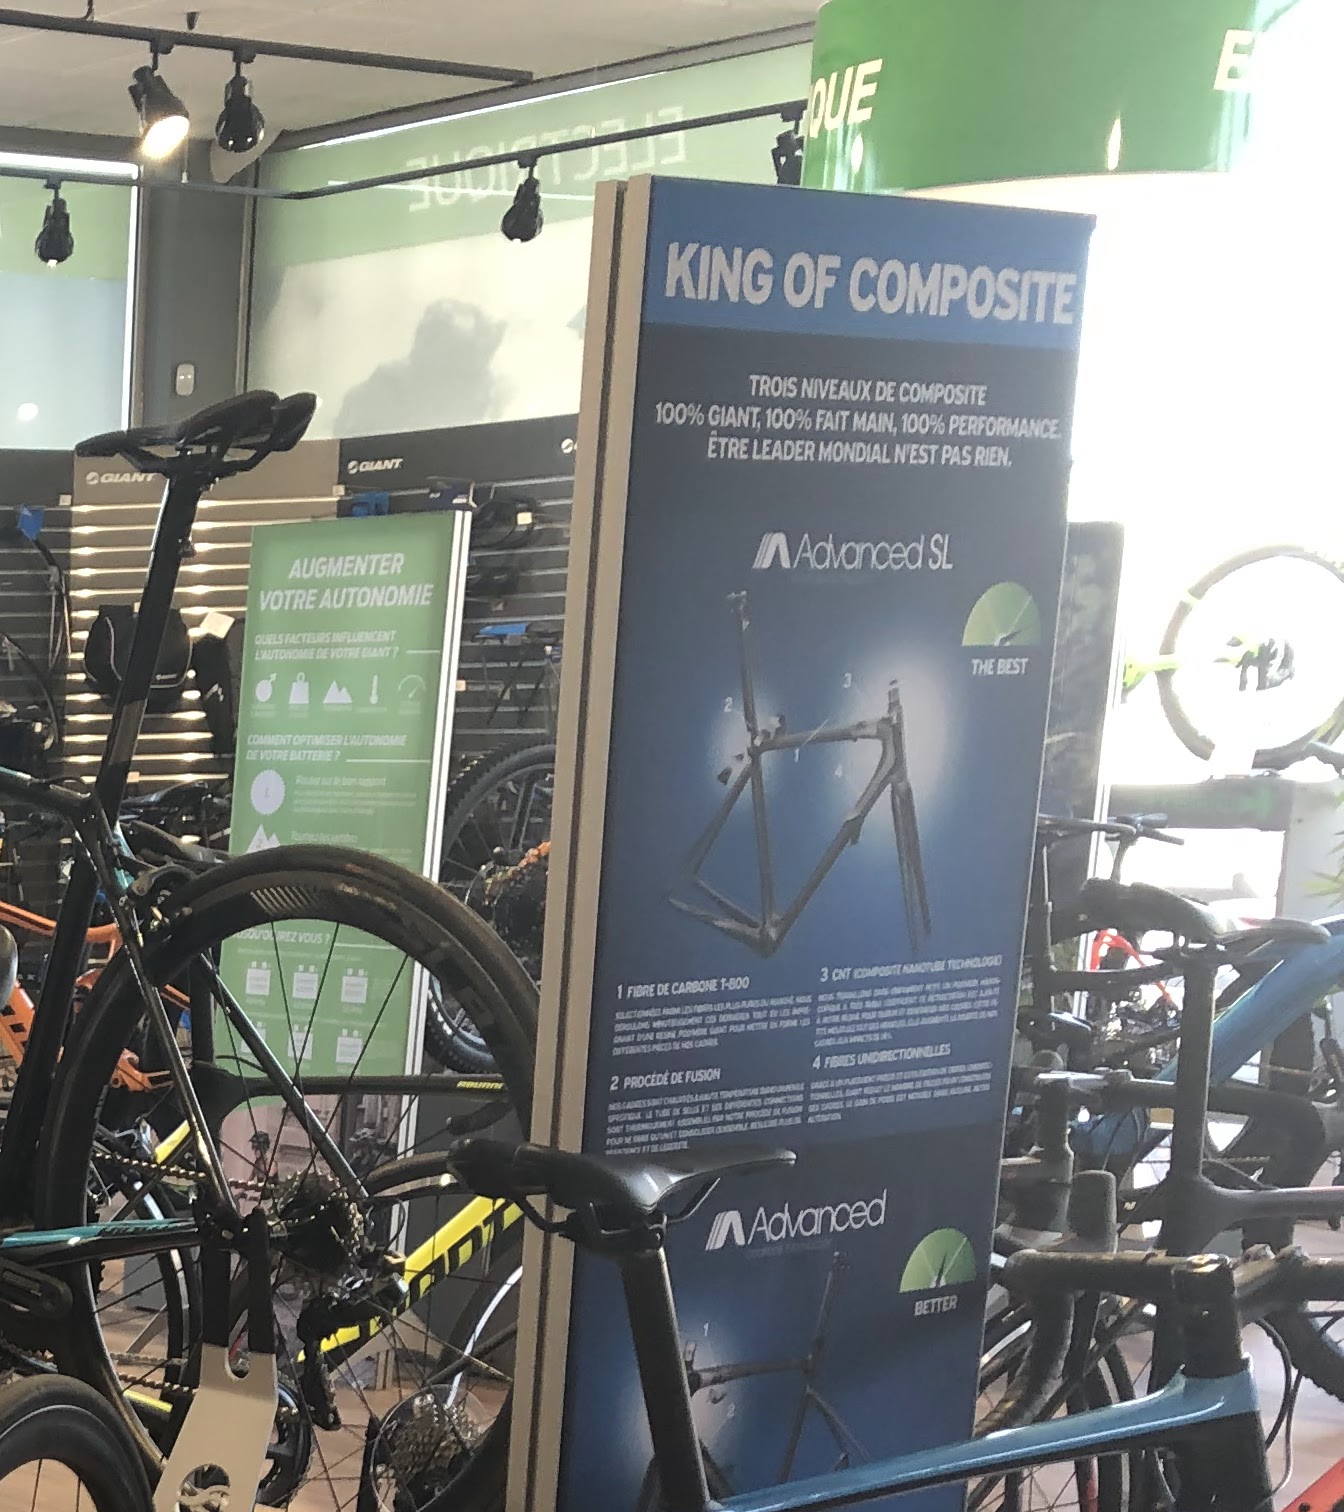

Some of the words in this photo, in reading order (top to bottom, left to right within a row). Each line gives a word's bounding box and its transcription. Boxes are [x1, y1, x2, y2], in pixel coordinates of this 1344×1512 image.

[665, 242, 774, 305] KING
[783, 251, 843, 309] OF
[849, 257, 1078, 325] COMPOSITE
[749, 374, 798, 399] TROIS
[800, 377, 872, 401] NIVEAUX
[875, 380, 897, 402] DE
[899, 381, 988, 405] COMPOSITE
[655, 401, 705, 426] 100%
[708, 405, 761, 432] GIANT,
[765, 408, 812, 430] 100%
[815, 409, 851, 431] FAIT
[853, 410, 897, 436] MAIN,
[901, 413, 946, 435] 100%
[707, 430, 748, 459] ÊTRE
[752, 437, 814, 462] LEADER
[818, 441, 891, 464] MONDIAL
[894, 443, 938, 465] N'EST
[941, 445, 972, 466] PAS
[974, 446, 1012, 468] RIEN.
[359, 457, 404, 472] GIANT
[98, 472, 156, 484] GIANT
[792, 532, 924, 570] Advanced
[928, 534, 954, 570] SL
[288, 553, 405, 579] AUGMENTER
[259, 588, 318, 611] VOTRE
[318, 584, 434, 608] AUTONOMIE
[971, 658, 995, 676] THE
[997, 658, 1028, 676] BEST
[819, 966, 829, 982] 3
[626, 983, 655, 999] FIBRE
[657, 982, 670, 997] DE
[671, 978, 718, 995] CARBONE
[812, 1054, 821, 1070] 4
[609, 1075, 619, 1091] 2
[623, 1069, 669, 1090] PROCÉDÉ
[670, 1070, 684, 1085] DE
[685, 1067, 721, 1083] FUSION
[747, 1187, 888, 1246] Advanced
[914, 1295, 958, 1317] BETTER
